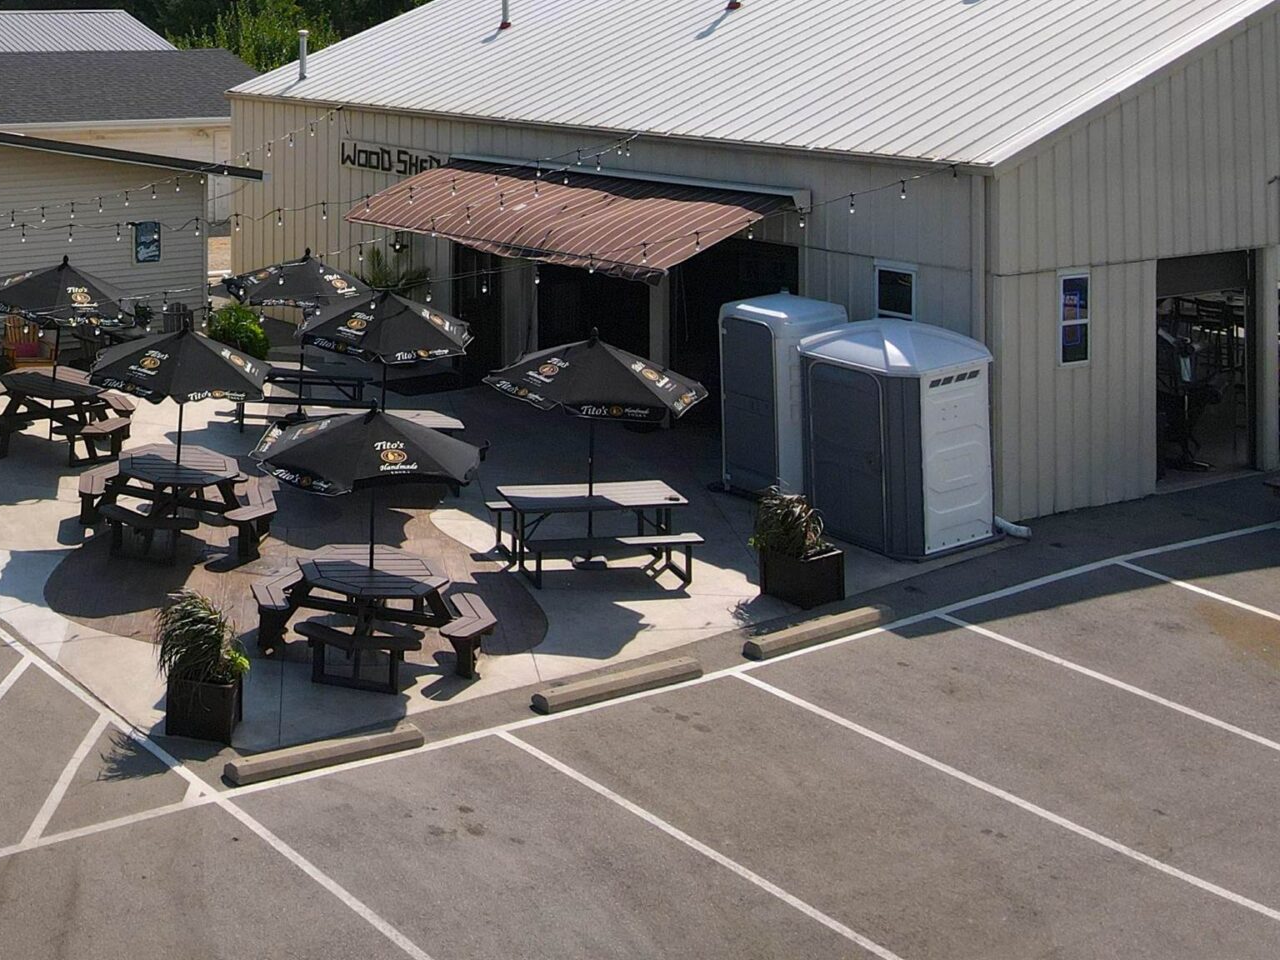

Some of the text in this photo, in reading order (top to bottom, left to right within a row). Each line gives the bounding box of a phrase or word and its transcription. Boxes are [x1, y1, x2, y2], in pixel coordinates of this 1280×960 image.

[313, 338, 336, 349] Tito's
[396, 350, 417, 360] Tito's
[496, 380, 519, 394] Tito's
[188, 390, 211, 401] Tito's
[581, 405, 609, 416] Tito's
[373, 441, 405, 451] Tito's
[379, 462, 418, 472] Handmade
[273, 469, 300, 484] Tito's
